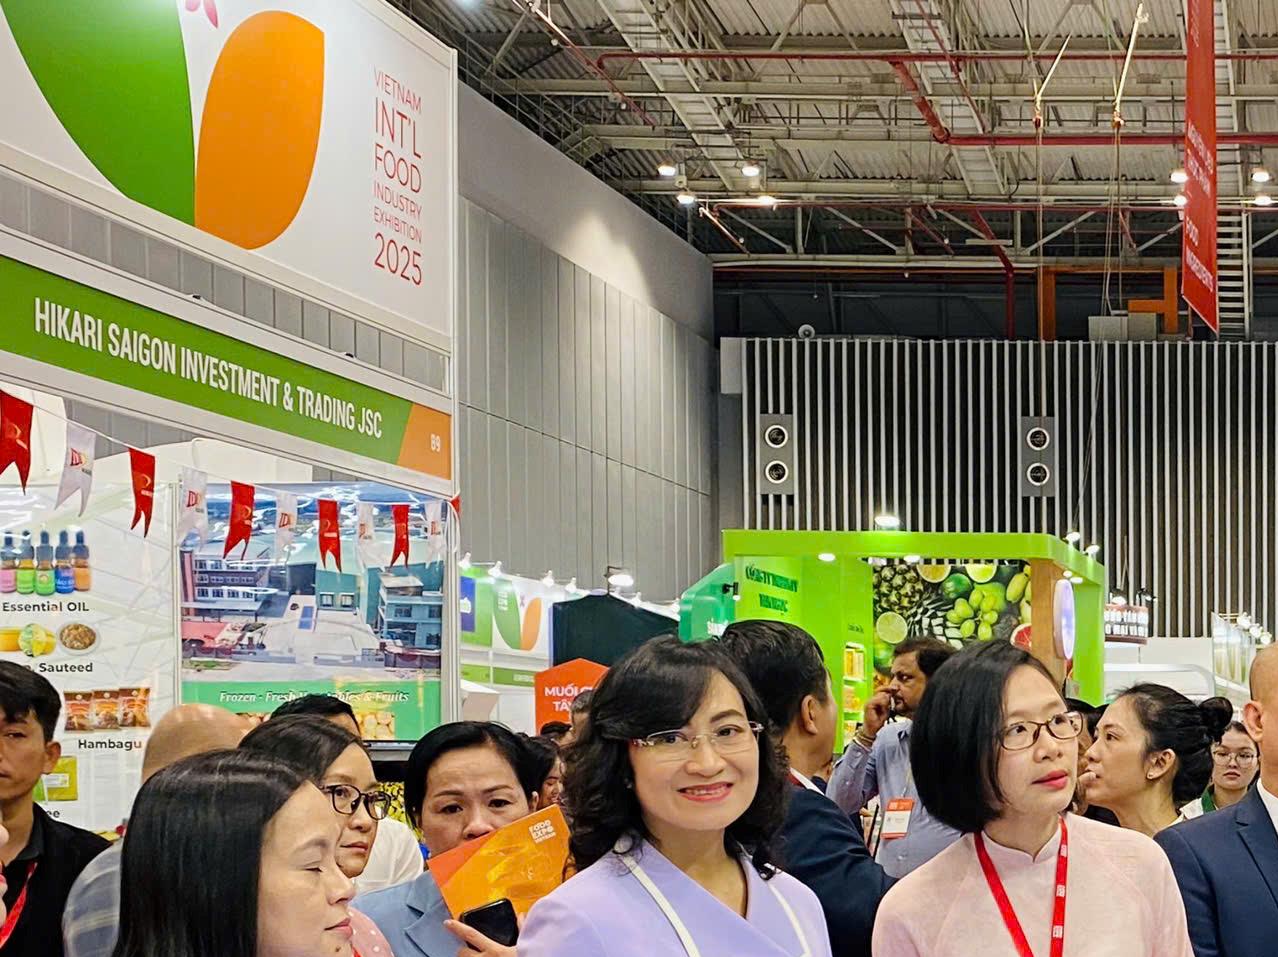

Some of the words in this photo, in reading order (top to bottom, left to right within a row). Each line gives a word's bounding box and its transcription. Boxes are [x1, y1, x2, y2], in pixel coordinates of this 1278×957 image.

[374, 67, 421, 114] VIETNAM
[375, 142, 421, 193] FOOD
[373, 181, 422, 219] INDUSTRY
[374, 206, 422, 243] EXHIBITION
[374, 232, 422, 285] 2025
[35, 297, 102, 352] HIKARI
[108, 323, 176, 375] SAIGON
[180, 347, 280, 407] INVESTMENT
[283, 381, 293, 411] &
[296, 386, 355, 431] TRADING
[358, 407, 383, 439] JSC
[2, 601, 63, 612] Essential
[67, 602, 90, 612] OIL
[39, 662, 93, 673] Sauteed
[219, 691, 256, 702] Frozen
[375, 690, 410, 702] Fruits
[552, 698, 572, 712] TÂ
[78, 738, 142, 751] Hambagu
